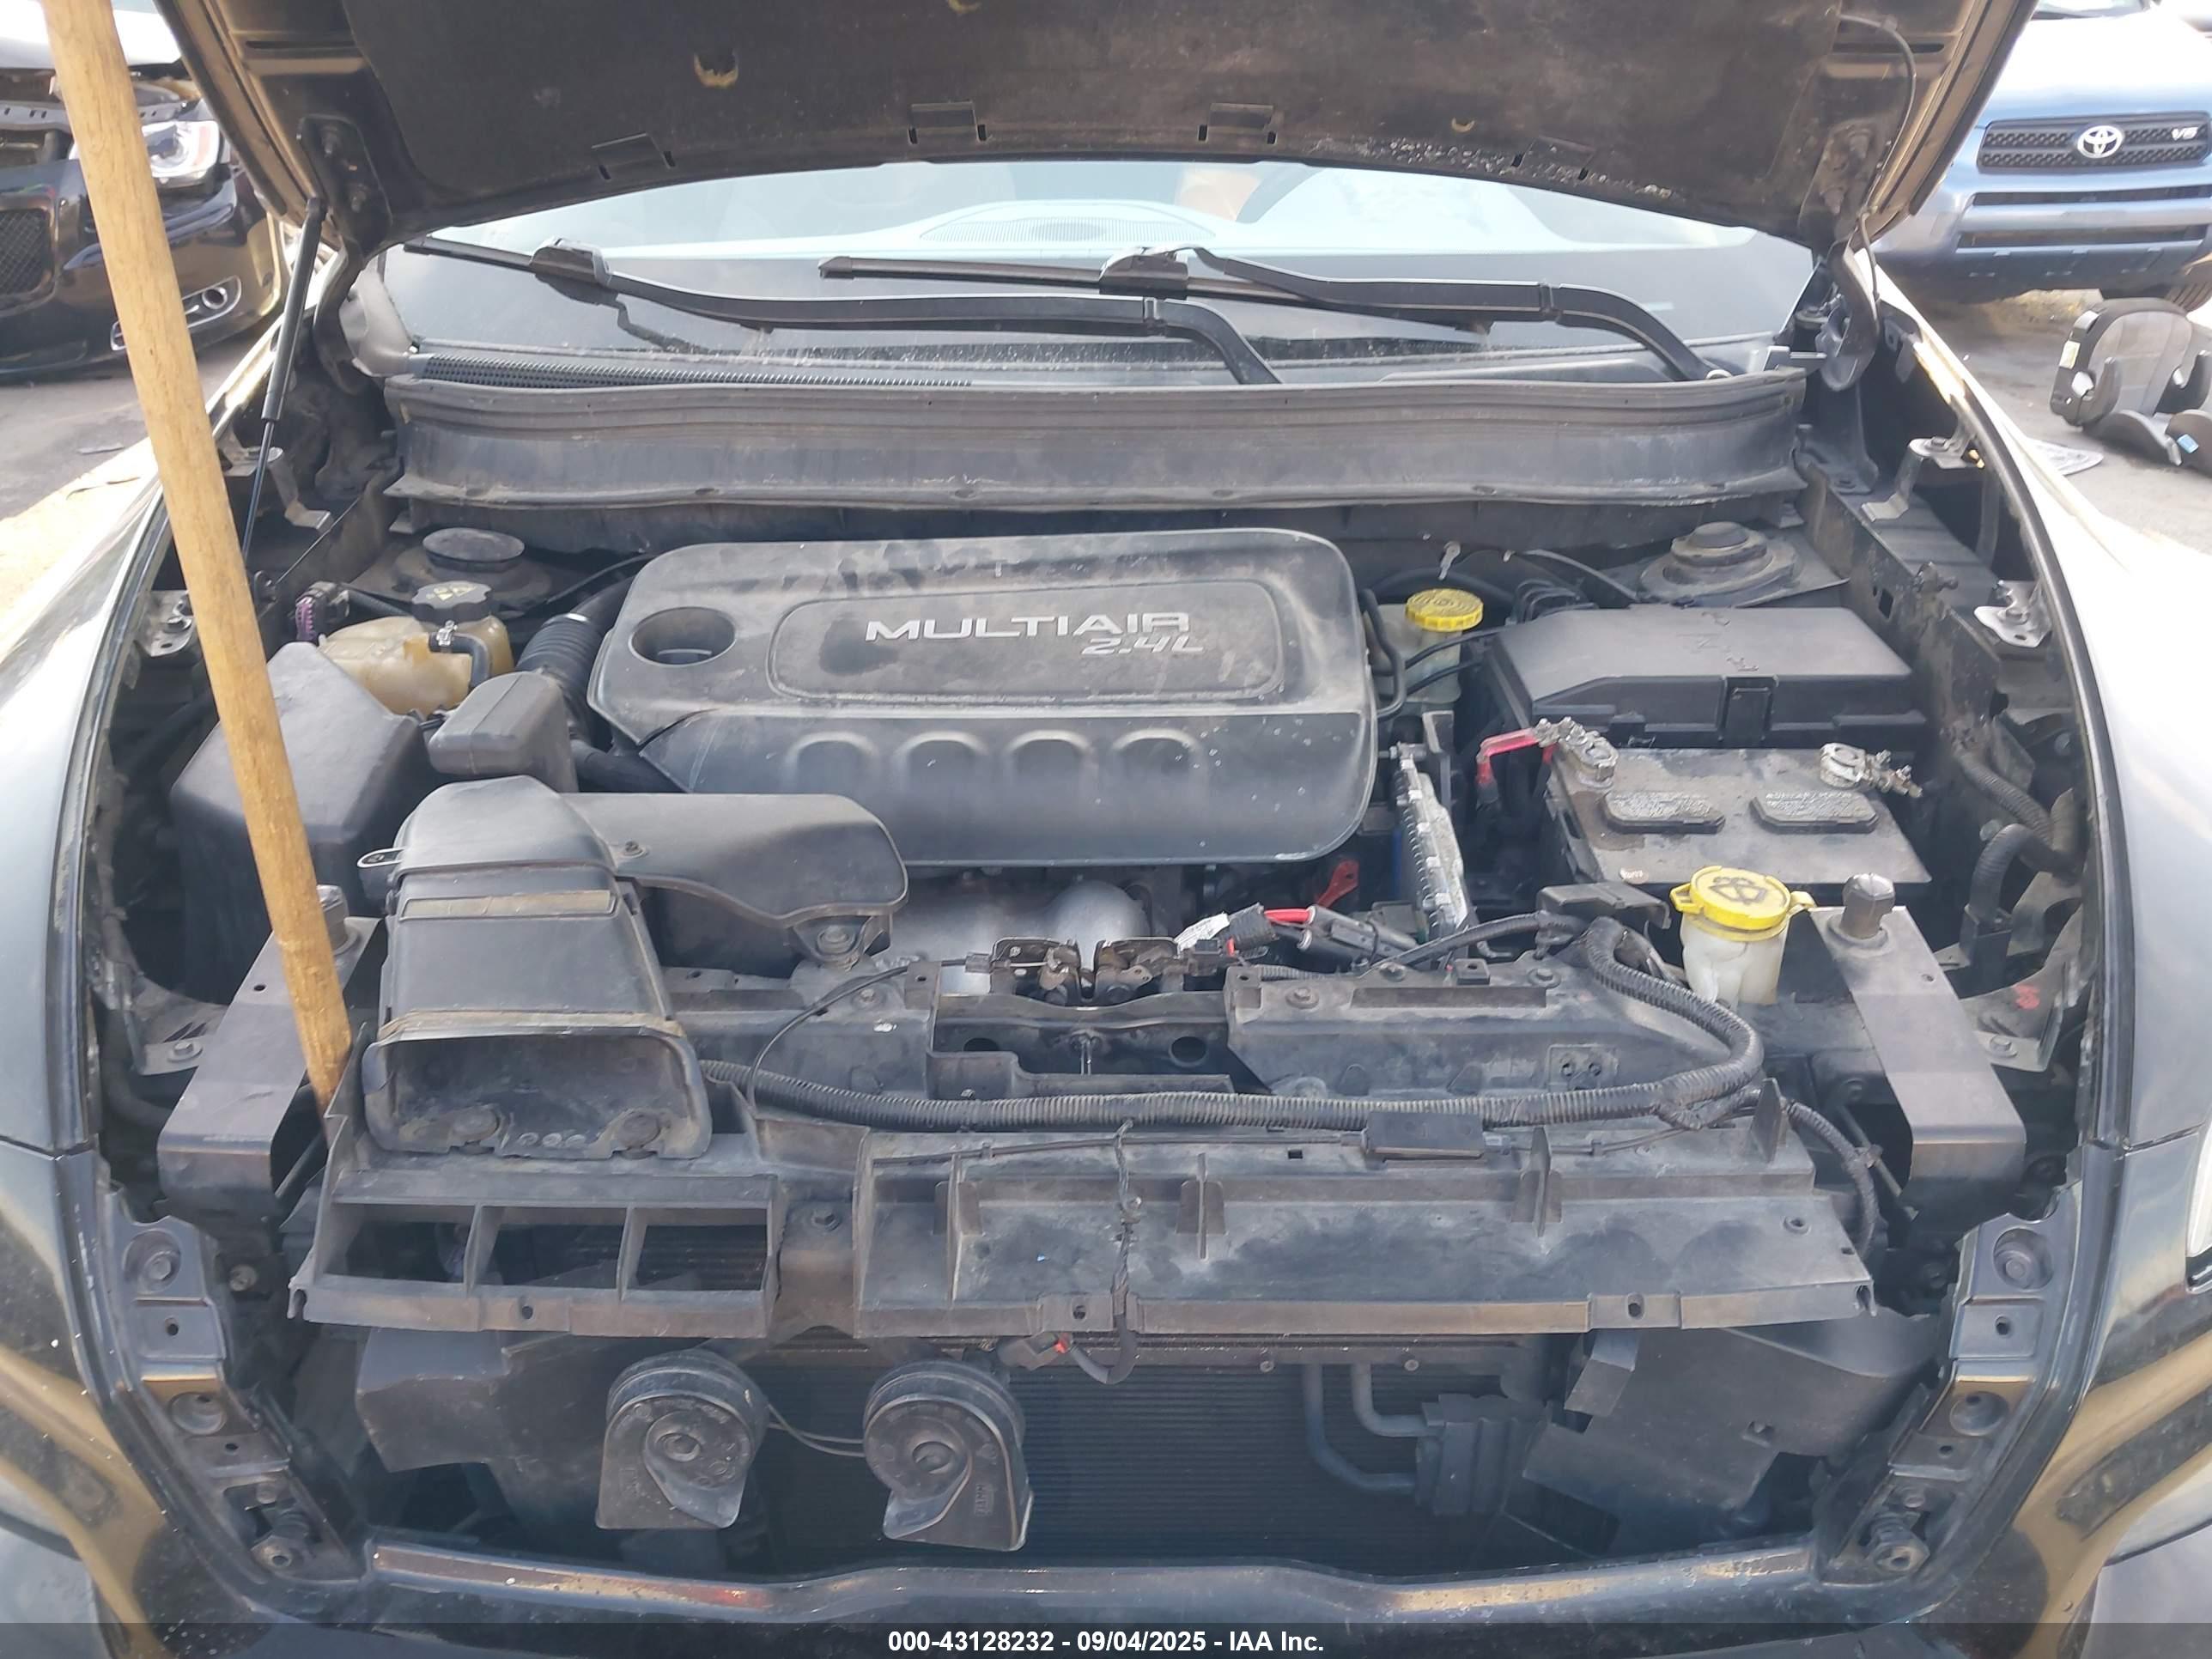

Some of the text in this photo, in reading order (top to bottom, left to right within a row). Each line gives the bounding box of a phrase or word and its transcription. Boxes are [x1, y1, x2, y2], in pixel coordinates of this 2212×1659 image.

[2171, 126, 2199, 142] V6
[865, 611, 1190, 642] MULTIAIR
[1080, 635, 1204, 656] 2.4L
